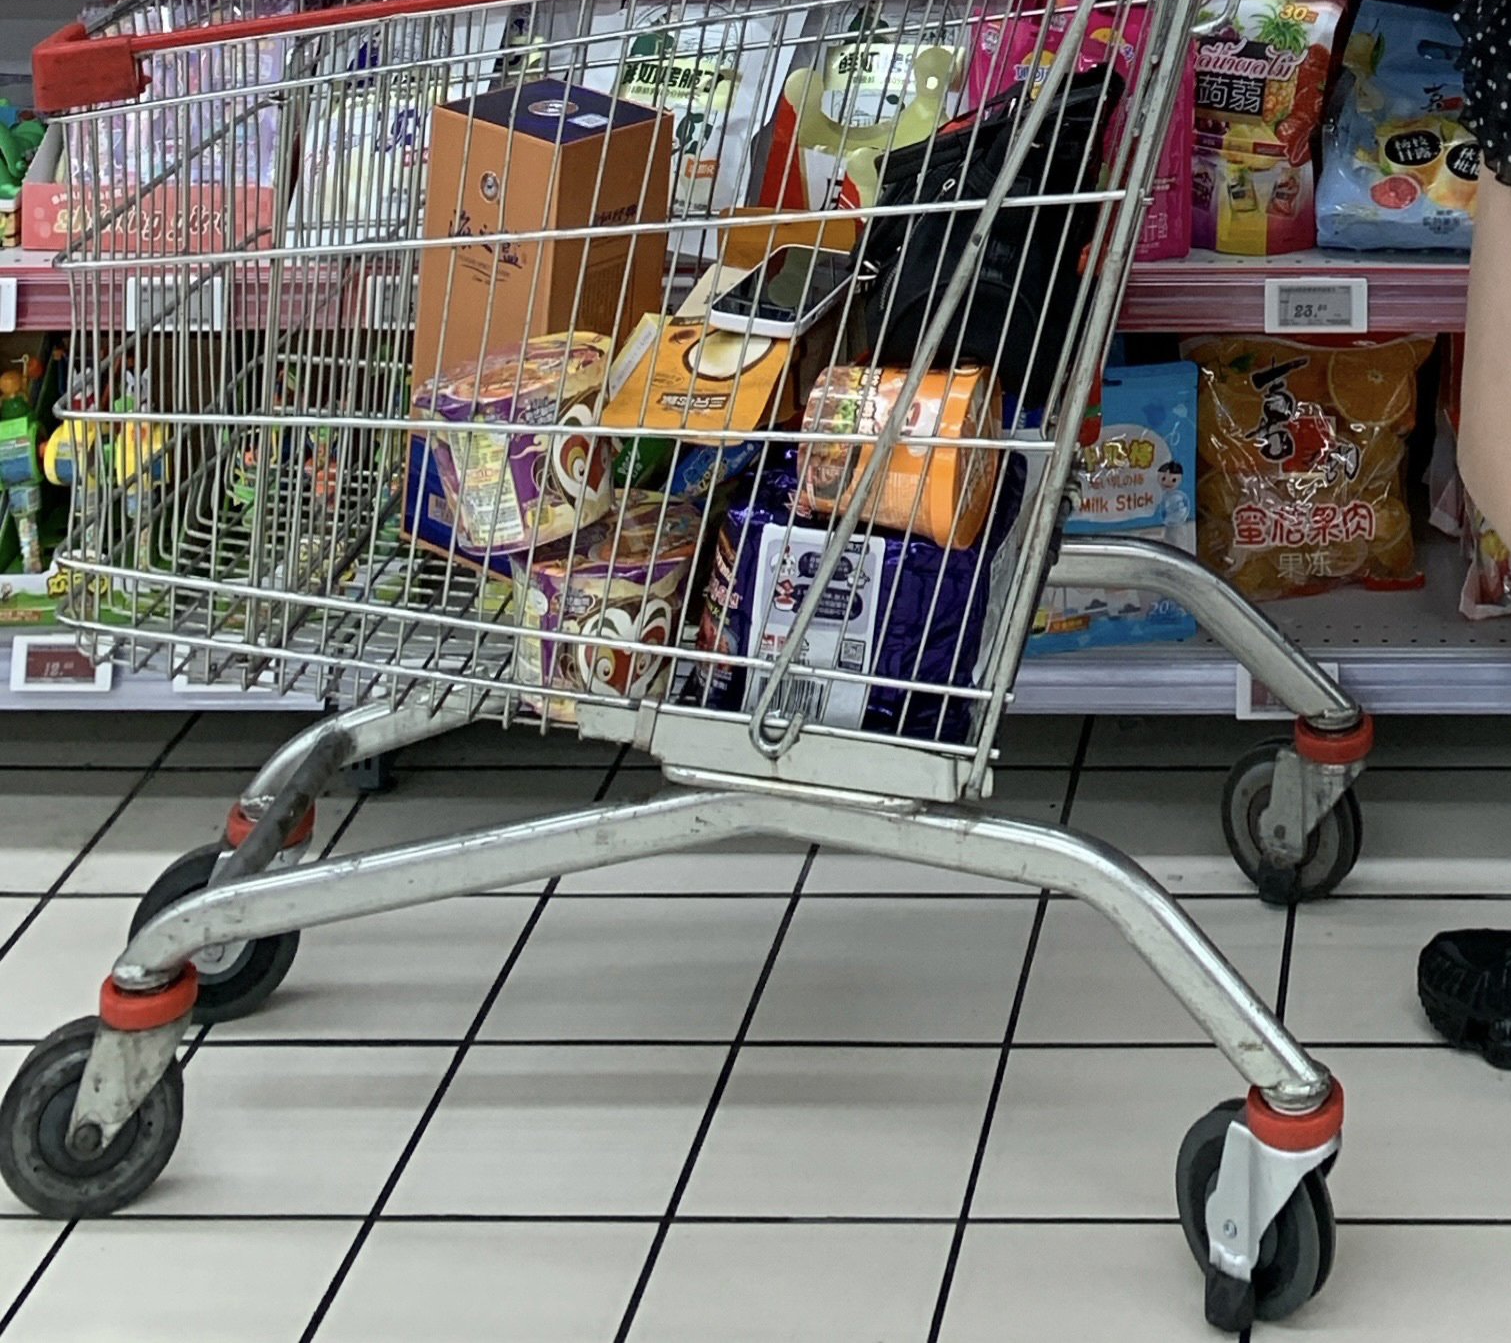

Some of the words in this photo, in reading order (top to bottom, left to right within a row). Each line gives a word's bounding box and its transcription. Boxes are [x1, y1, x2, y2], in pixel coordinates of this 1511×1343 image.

[1198, 76, 1265, 113] 蒟蒻
[1115, 492, 1154, 511] Stick
[1278, 552, 1333, 578] 果冻
